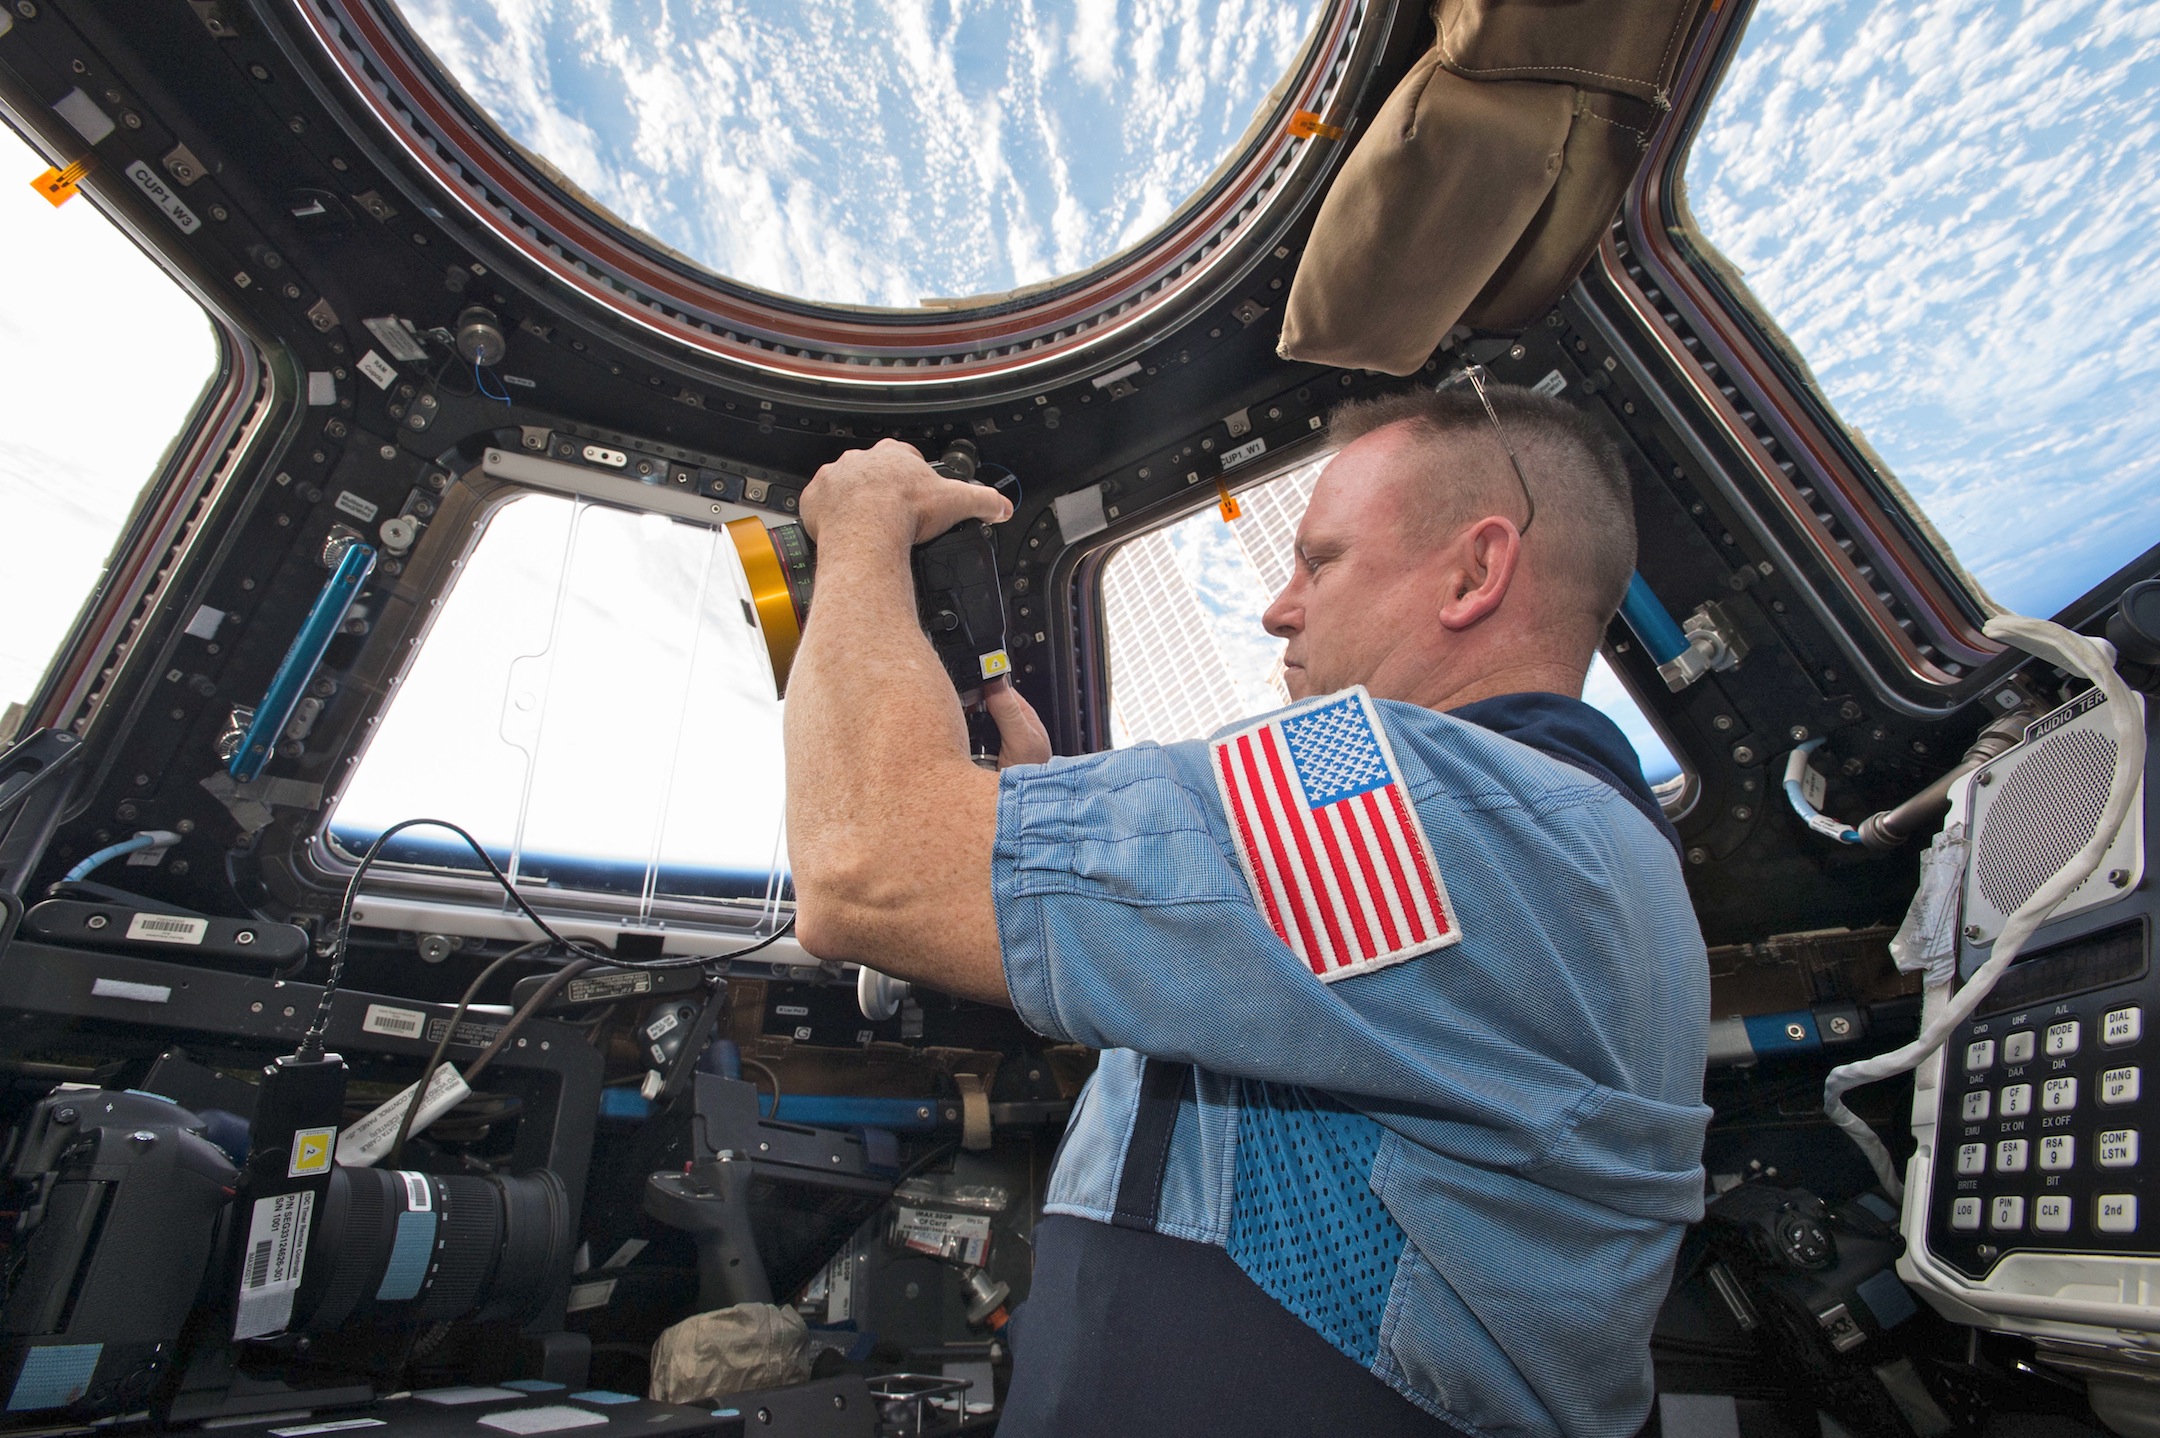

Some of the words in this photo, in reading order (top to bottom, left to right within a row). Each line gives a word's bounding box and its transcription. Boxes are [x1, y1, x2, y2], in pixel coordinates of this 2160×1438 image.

[135, 169, 193, 227] CUP1_W3
[238, 275, 247, 284] 2
[374, 360, 388, 374] RAM
[2036, 709, 2073, 738] AUDIO
[2079, 692, 2108, 713] TER
[2055, 1004, 2069, 1015] A/L
[2012, 1014, 2027, 1026] UHF
[2109, 1010, 2130, 1023] DIAL
[797, 1027, 809, 1039] G
[1973, 1024, 1989, 1035] GND
[2050, 1024, 2073, 1035] NODE
[2110, 1024, 2129, 1036] ANS
[859, 1031, 872, 1041] H
[1972, 1042, 1986, 1052] HAB
[2056, 1037, 2063, 1049] 3
[2014, 1046, 2020, 1057] 2
[1976, 1055, 1981, 1064] 1
[2052, 1059, 2067, 1070] DIA
[2008, 1067, 2024, 1078] DAA
[2105, 1070, 2131, 1083] HANG
[1969, 1074, 1984, 1084] DAG
[426, 1080, 448, 1098] VIDEO
[2047, 1080, 2069, 1091] CPLA
[2111, 1084, 2124, 1096] UP
[1968, 1092, 1982, 1103] LAB
[2010, 1087, 2020, 1097] CF
[2053, 1092, 2060, 1104] 6
[377, 1094, 408, 1118] CONTROL
[1971, 1104, 1977, 1115] 4
[2010, 1099, 2016, 1111] 5
[356, 1115, 378, 1133] PANEL
[368, 1113, 400, 1138] (CENTER)
[2001, 1123, 2011, 1133] EX
[2012, 1121, 2025, 1131] ON
[2042, 1118, 2053, 1128] EX
[2054, 1115, 2072, 1126] OFF
[380, 1123, 398, 1138] DATA
[1965, 1126, 1981, 1136] EMU
[359, 1134, 382, 1153] CABLE
[2045, 1138, 2063, 1148] RSA
[2101, 1132, 2128, 1144] CONF
[1963, 1145, 1977, 1155] JEM
[2003, 1142, 2018, 1152] ESA
[2102, 1147, 2127, 1159] LSTN
[1966, 1157, 1972, 1169] 7
[2006, 1154, 2013, 1166] 8
[2050, 1151, 2057, 1164] 9
[1957, 1180, 1978, 1190] BRITE
[2046, 1176, 2060, 1186] BIT
[274, 1197, 284, 1213] S/N
[286, 1194, 296, 1210] P/N
[1999, 1198, 2012, 1208] PIN
[302, 1203, 311, 1225] Timer
[915, 1211, 933, 1219] IMAX
[934, 1212, 953, 1220] 32GB
[1957, 1205, 1972, 1215] LOG
[2042, 1205, 2060, 1216] CLR
[2104, 1205, 2122, 1216] 2nd
[271, 1212, 281, 1232] 1001
[2001, 1211, 2008, 1223] 0
[298, 1224, 307, 1248] Remote
[273, 1210, 293, 1282] SEG33124626-301
[291, 1247, 304, 1279] Controller
